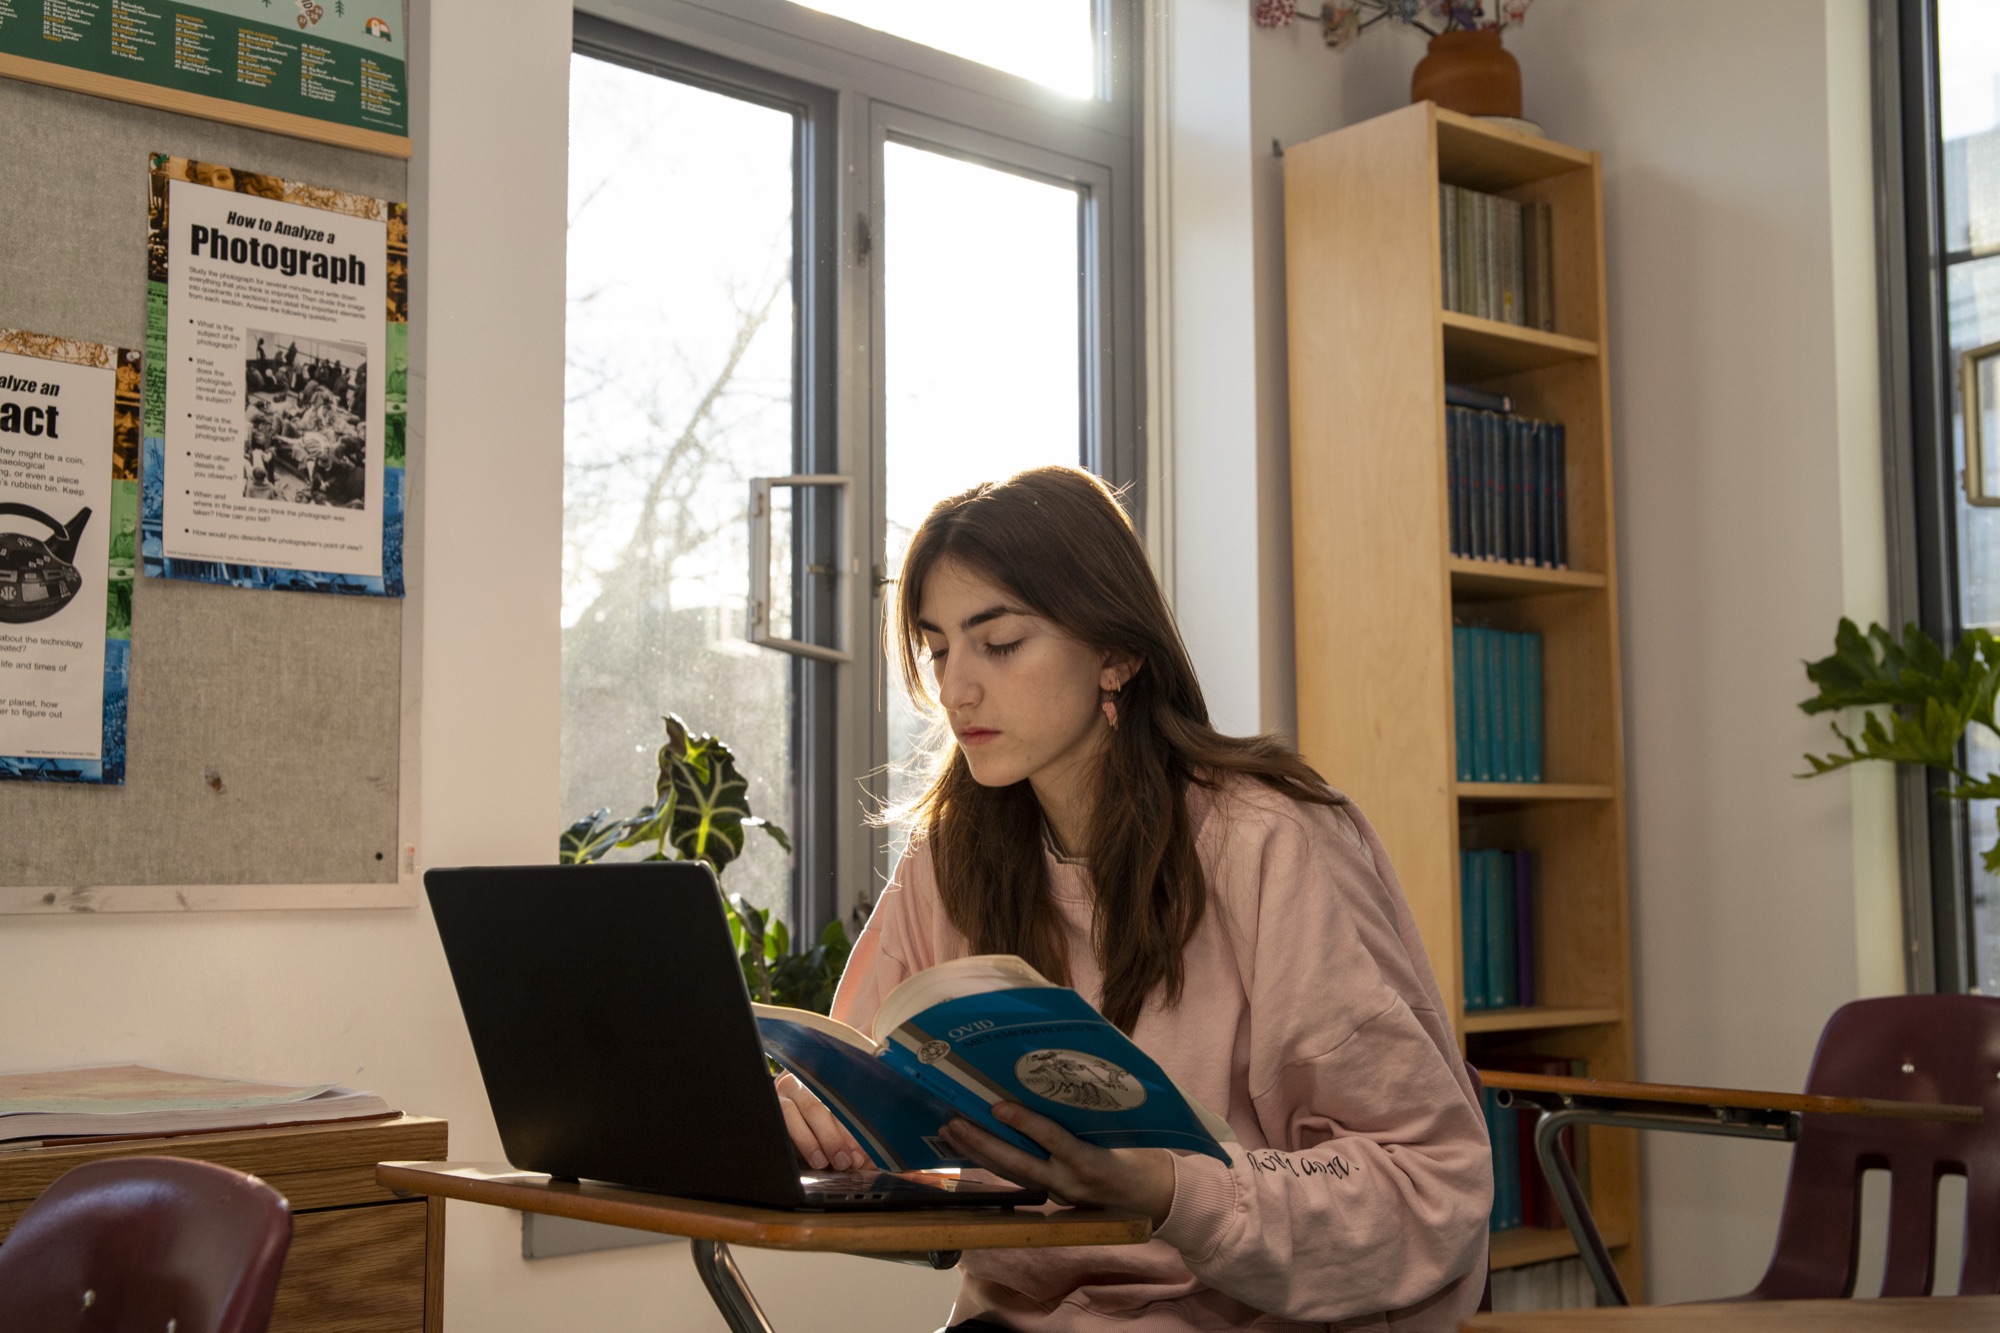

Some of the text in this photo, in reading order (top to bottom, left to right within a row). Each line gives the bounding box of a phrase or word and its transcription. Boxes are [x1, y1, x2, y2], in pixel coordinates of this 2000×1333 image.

[227, 211, 336, 244] How to Analyze a
[191, 224, 366, 286] Photograph
[189, 266, 206, 276] Study
[220, 272, 254, 283] photograph
[266, 281, 287, 289] several
[289, 285, 311, 293] minutes
[341, 293, 356, 301] down
[189, 276, 220, 287] everything
[249, 285, 262, 293] think
[318, 298, 335, 306] divide
[348, 303, 365, 312] image
[189, 292, 202, 300] from
[221, 298, 244, 307] section.
[246, 302, 269, 311] Answer
[281, 308, 307, 319] following
[202, 287, 232, 296] quadrants
[242, 294, 269, 304] sections)
[311, 306, 338, 314] important
[340, 311, 366, 319] elements
[197, 320, 214, 328] What
[197, 330, 220, 338] subject
[196, 339, 237, 349] photograph?
[196, 358, 214, 366] What
[0, 375, 60, 397] alyze an
[196, 377, 232, 387] photograph
[205, 396, 232, 404] subject?
[0, 402, 59, 439] act
[195, 424, 216, 432] setting
[195, 433, 235, 442] photograph?
[19, 450, 42, 460] might
[44, 453, 55, 461] be
[65, 456, 84, 465] coin,
[194, 452, 211, 460] What
[57, 475, 79, 485] piece
[208, 472, 237, 480] observe?
[11, 480, 42, 491] rubbish
[44, 484, 59, 493] bin.
[63, 487, 84, 497] Keep
[193, 490, 212, 498] When
[298, 512, 331, 520] photograph
[241, 534, 266, 542] describe
[279, 538, 322, 547] photographer's
[323, 542, 338, 550] point
[0, 634, 83, 649] about the technology
[1, 660, 67, 672] life and times of
[9, 698, 38, 708] planet,
[41, 700, 58, 708] how
[11, 708, 19, 716] to
[22, 709, 46, 718] figure
[948, 1020, 994, 1039] OVID
[963, 1024, 1086, 1048] METAMORPHOSES
